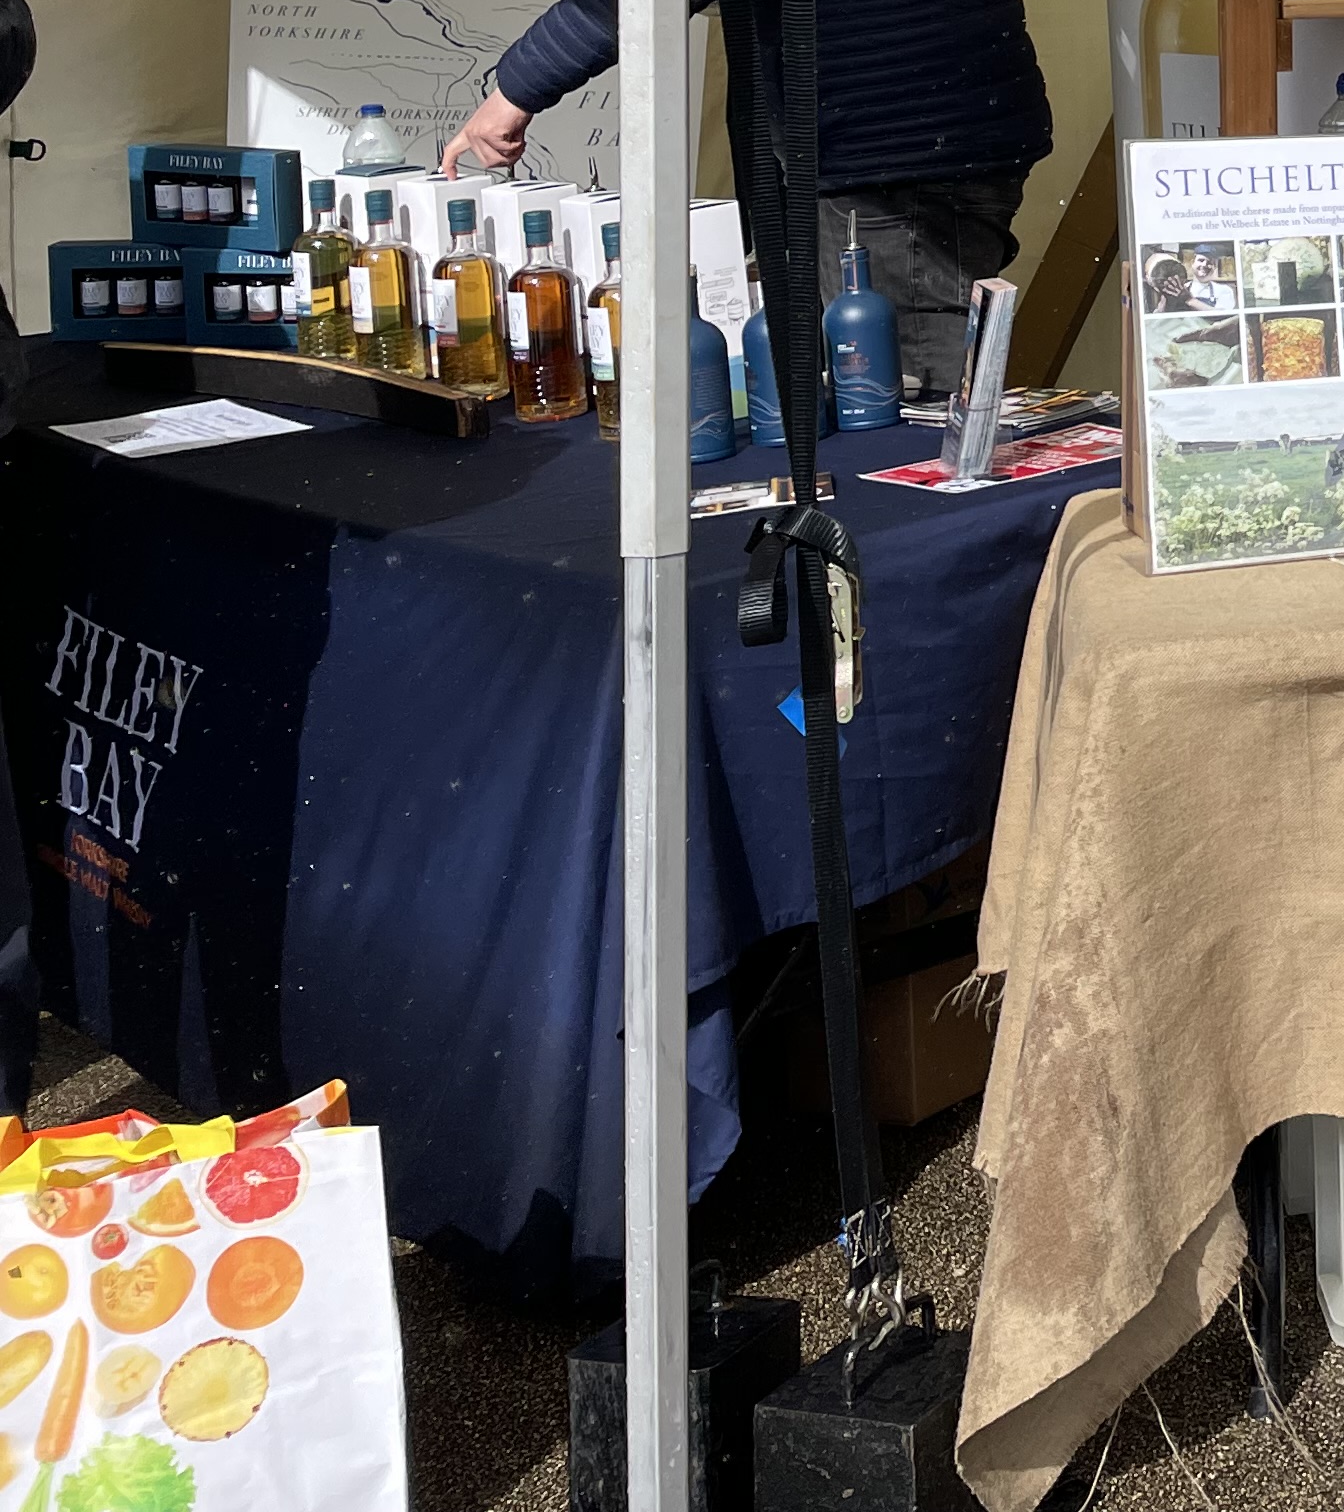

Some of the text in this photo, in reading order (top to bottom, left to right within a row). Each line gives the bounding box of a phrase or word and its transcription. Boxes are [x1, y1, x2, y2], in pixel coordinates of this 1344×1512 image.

[246, 3, 319, 19] NORTH
[246, 25, 367, 41] YORKSHIRE
[295, 105, 351, 119] SPIRIT
[389, 107, 475, 122] ORKSHIRE
[169, 154, 227, 170] FILEY BAY
[1162, 210, 1172, 219] A
[1172, 207, 1219, 219] traditional
[1220, 206, 1241, 217] blue
[1242, 205, 1270, 216] cheese
[1272, 203, 1297, 214] made
[1299, 202, 1320, 213] from
[1191, 222, 1203, 230] on
[1205, 220, 1219, 230] the
[1221, 217, 1260, 229] Welbeck
[1262, 217, 1290, 228] Estate
[1292, 217, 1300, 226] in
[111, 249, 157, 263] FILEY
[238, 255, 277, 269] FILEY
[45, 605, 204, 754] FILEY
[56, 717, 163, 854] BAY
